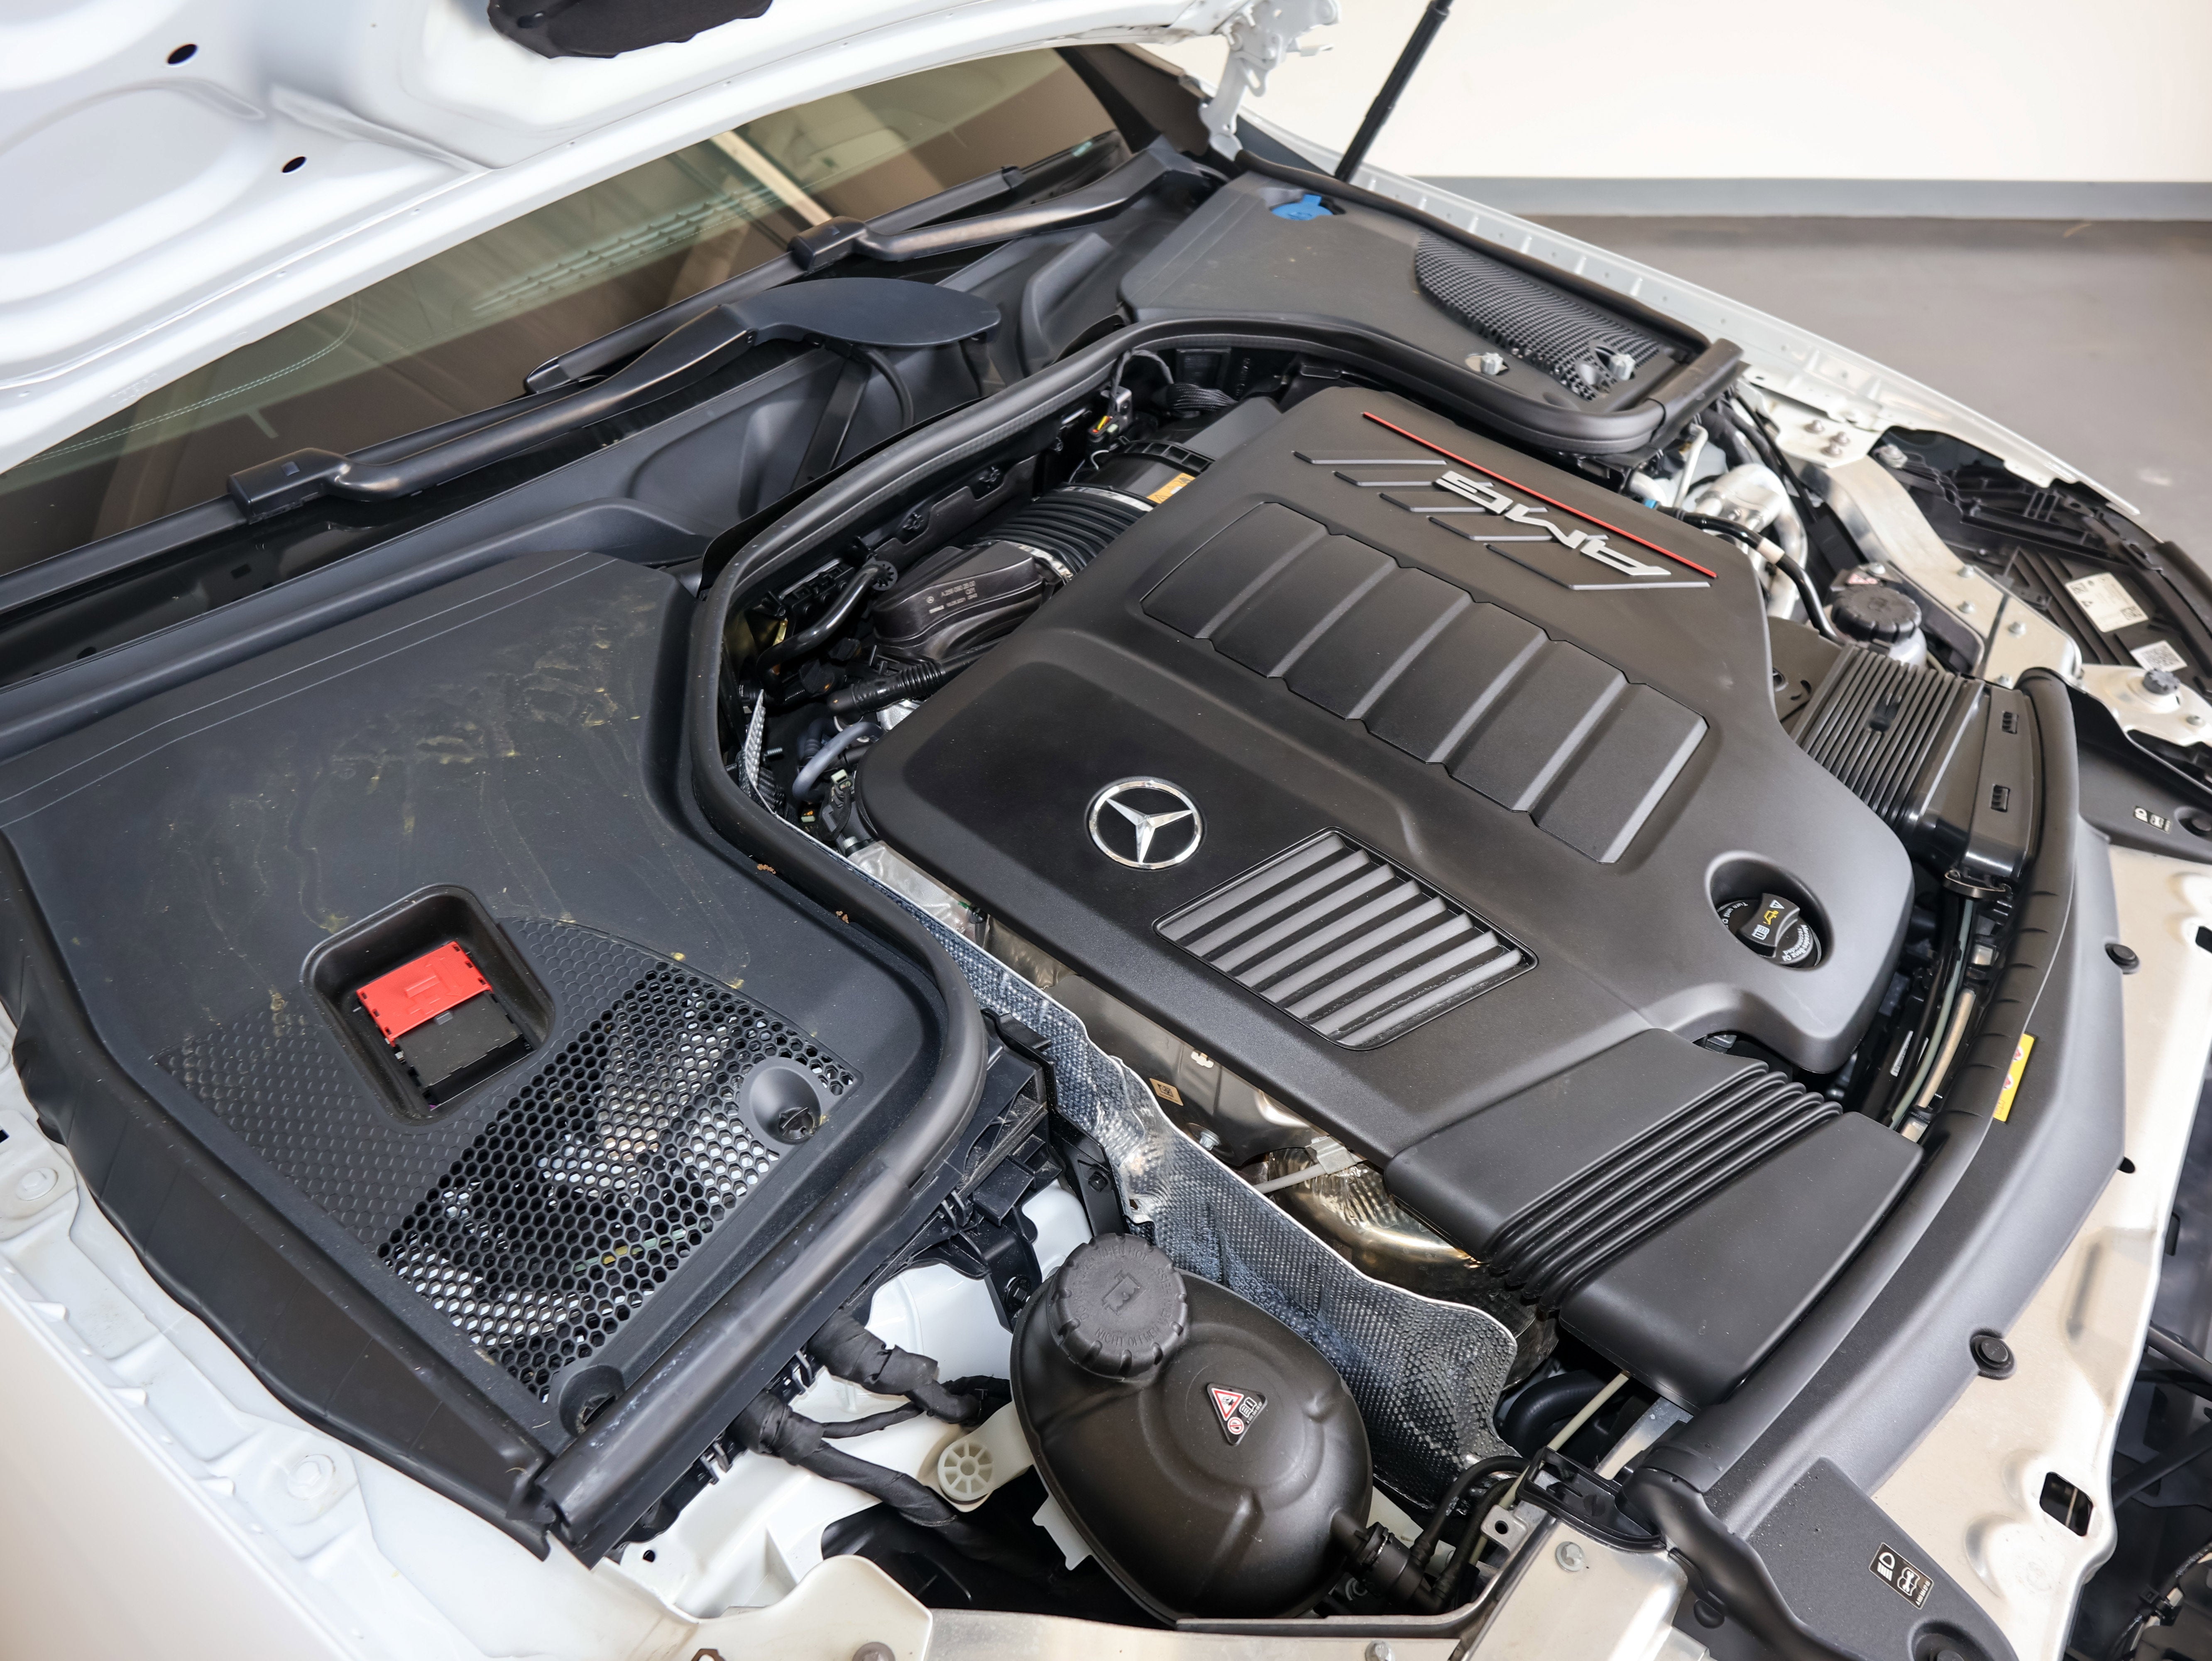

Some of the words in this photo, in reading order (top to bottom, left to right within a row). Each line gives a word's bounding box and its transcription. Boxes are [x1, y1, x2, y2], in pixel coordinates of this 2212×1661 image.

[1435, 470, 1671, 576] AMG
[1723, 908, 1734, 918] until
[1782, 928, 1804, 955] recommended
[1128, 1246, 1152, 1261] HOT
[1095, 1327, 1124, 1346] NICHT
